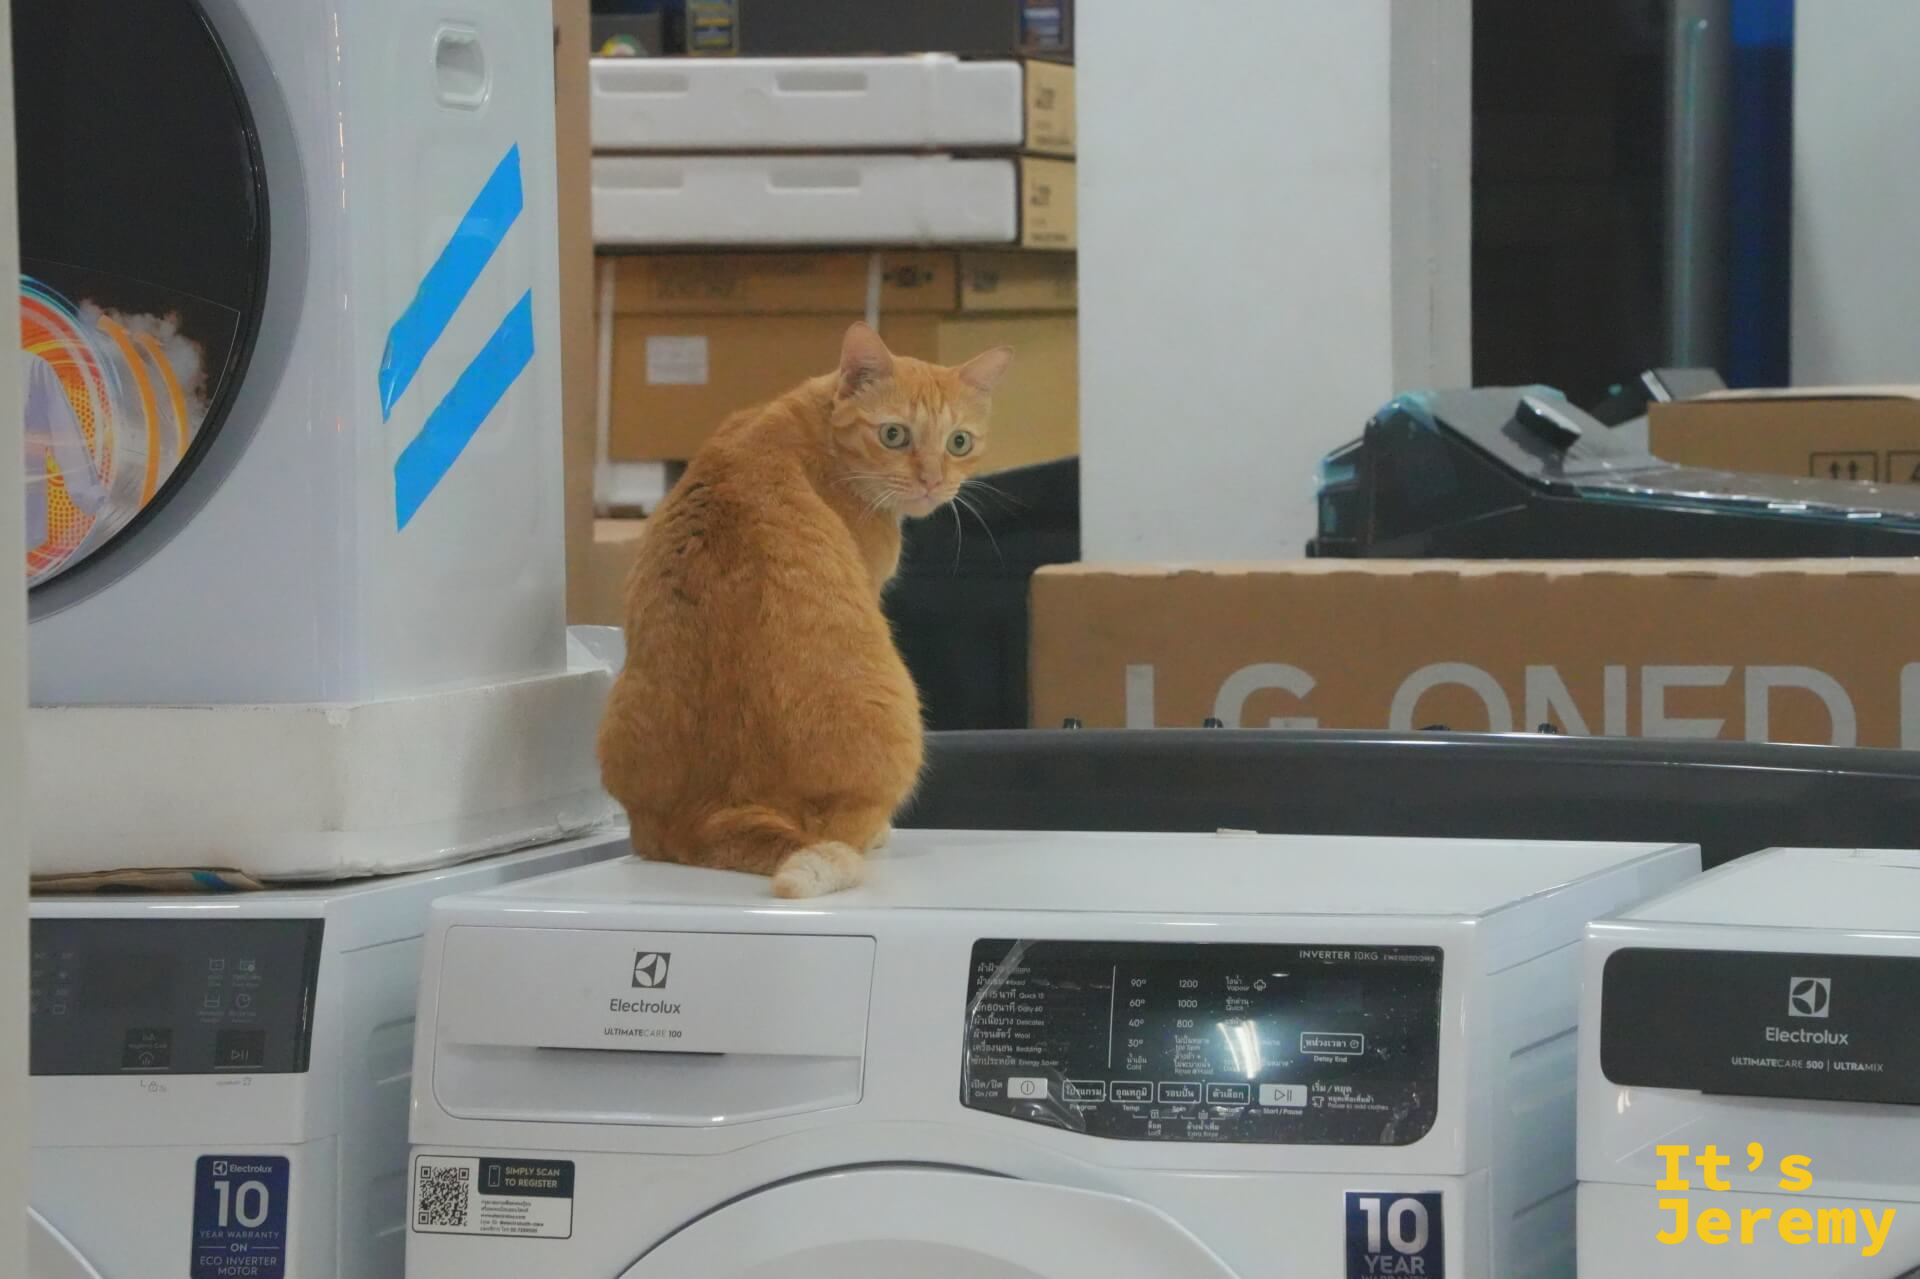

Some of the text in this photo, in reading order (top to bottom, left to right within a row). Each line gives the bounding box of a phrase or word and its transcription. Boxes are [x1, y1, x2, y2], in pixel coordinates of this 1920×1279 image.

[1299, 950, 1351, 960] INVERTER
[1354, 951, 1378, 961] 10KG
[1179, 979, 1199, 989] 1200
[609, 998, 681, 1014] Electrolux
[1178, 1000, 1198, 1009] 1000
[1177, 1020, 1194, 1028] 800
[604, 1027, 682, 1038] ULTIMATECARE 100
[1765, 1026, 1849, 1045] Electrolux
[1313, 1055, 1333, 1063] Delay
[1731, 1056, 1884, 1073] ULTIMATECARE 500 ULTRAMIX
[229, 1163, 273, 1174] Electrolux
[505, 1166, 560, 1177] SIMPLY SCAN
[504, 1178, 558, 1189] TO REGISTER
[214, 1180, 269, 1228] 10
[1359, 1197, 1429, 1255] 10
[200, 1230, 281, 1240] YEAR WARRANTY
[230, 1243, 248, 1252] ON
[200, 1256, 277, 1266] ECO INVERTER
[1364, 1255, 1425, 1275] YEAR
[217, 1266, 259, 1277] MOTOR
